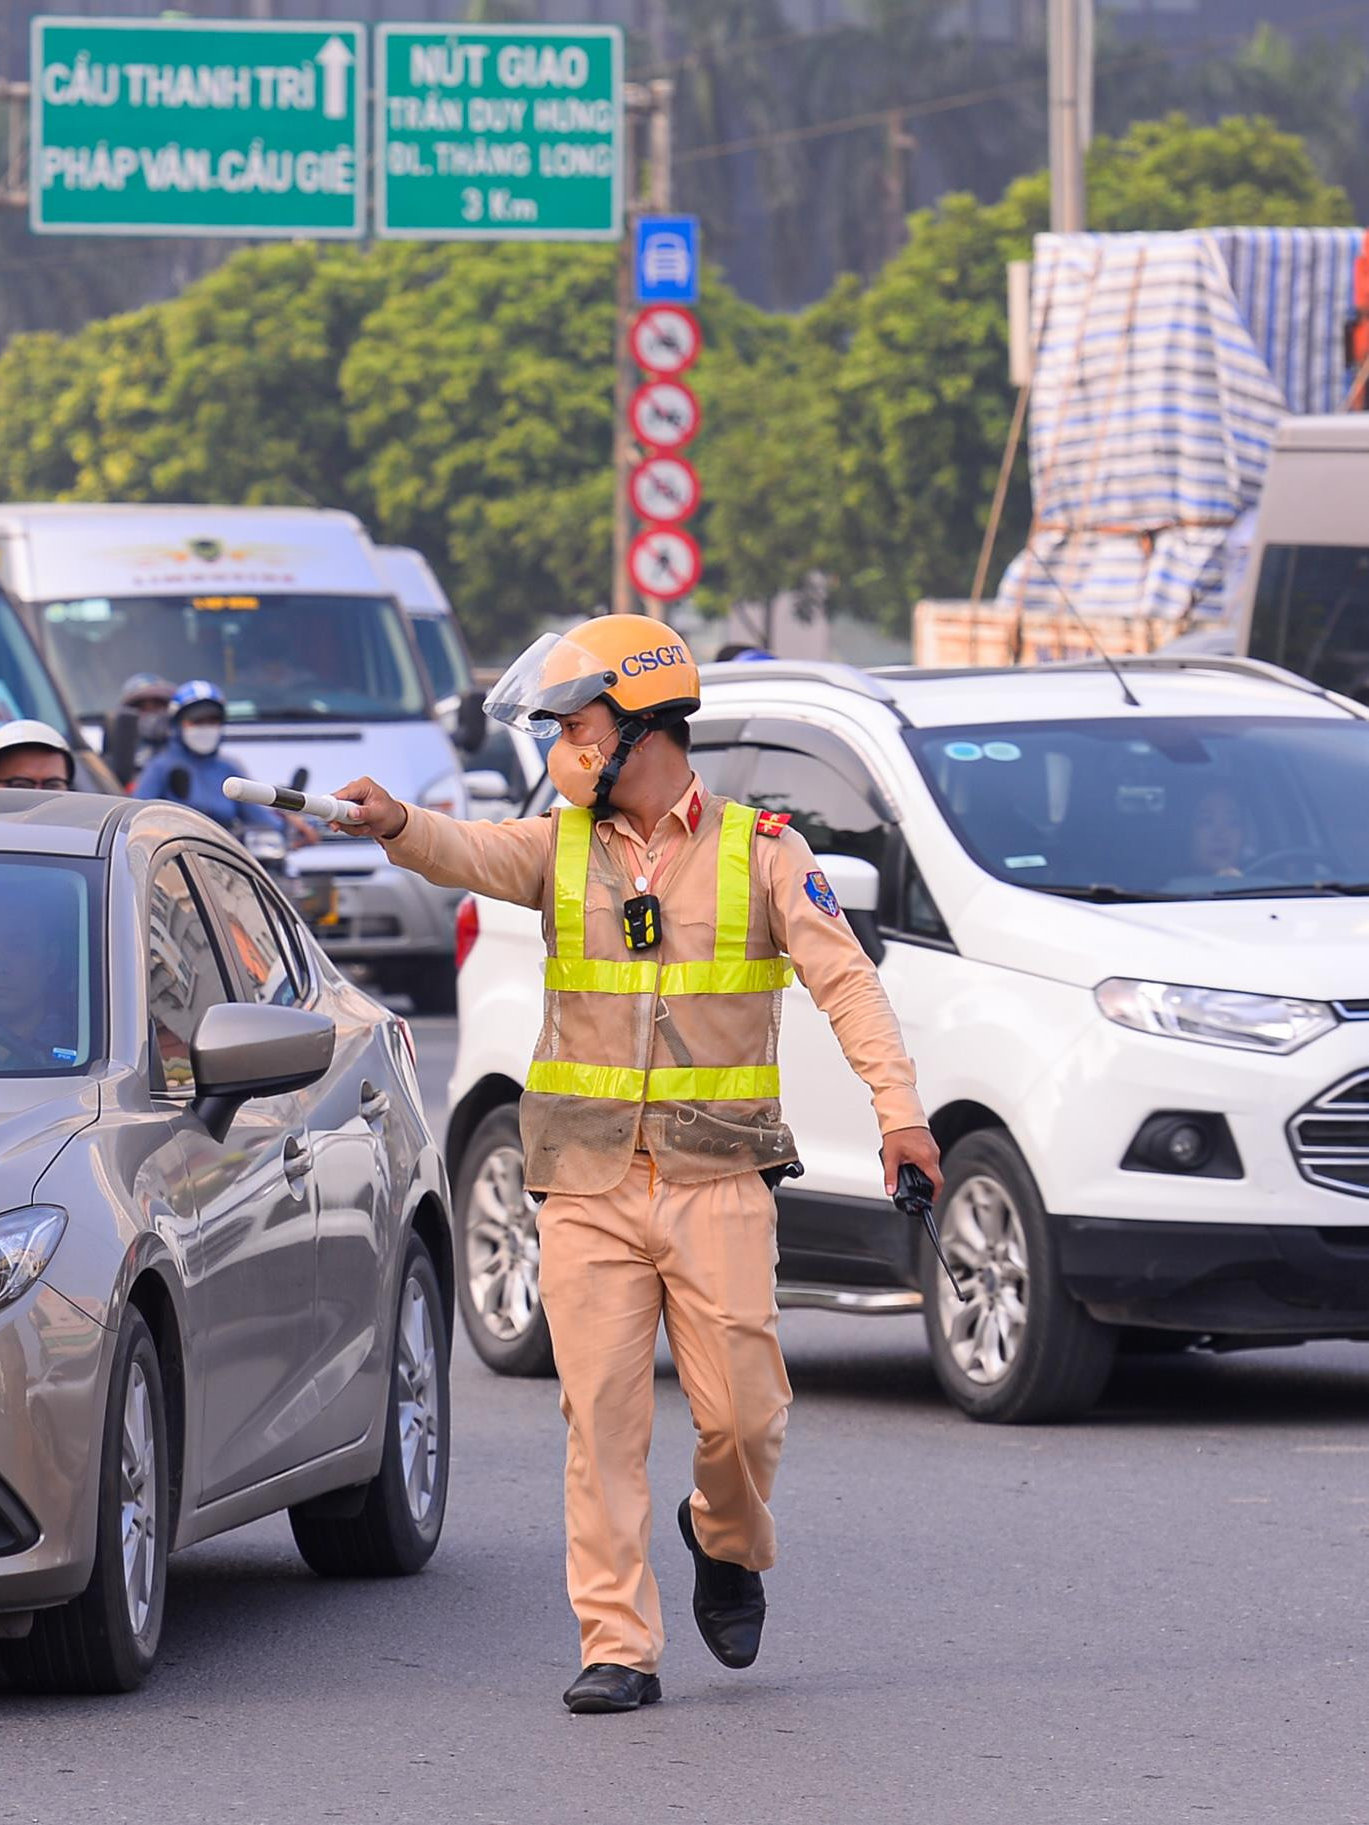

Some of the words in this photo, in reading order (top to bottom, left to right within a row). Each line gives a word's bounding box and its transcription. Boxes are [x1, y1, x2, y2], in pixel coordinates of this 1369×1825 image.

[410, 34, 490, 88] NÚT
[496, 44, 589, 89] GIAO
[123, 63, 251, 109] THANH
[253, 59, 316, 111] TRÌ
[468, 97, 529, 133] DUY
[42, 139, 139, 191] PHÁP
[539, 141, 613, 178] LONG
[461, 186, 484, 222] 3
[488, 187, 538, 222] Km
[621, 645, 687, 677] CSGT
